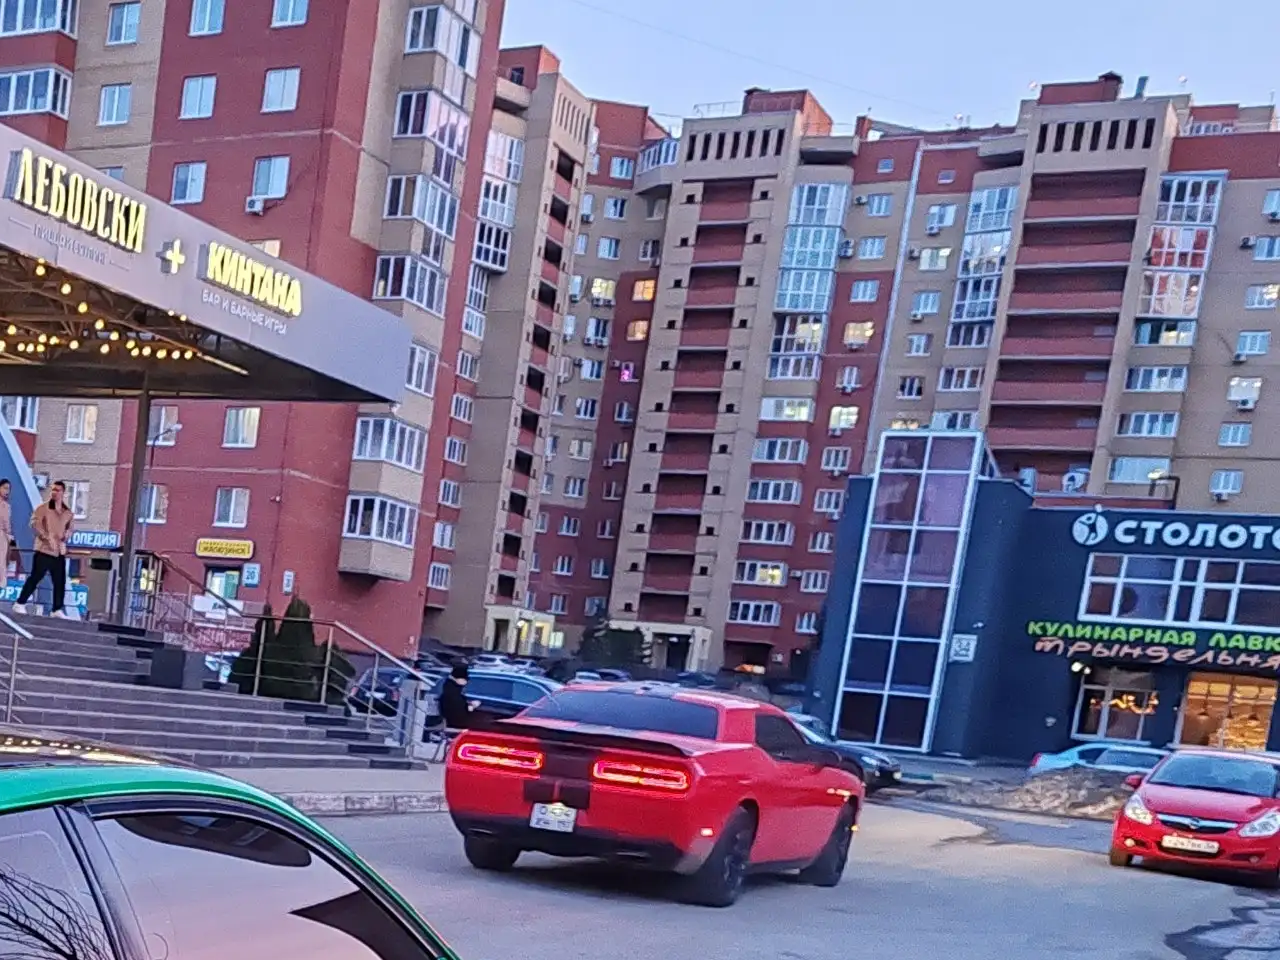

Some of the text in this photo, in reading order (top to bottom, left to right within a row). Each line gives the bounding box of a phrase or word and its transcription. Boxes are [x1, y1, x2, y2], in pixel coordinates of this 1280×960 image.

[14, 147, 147, 253] ЛЕБОВСКИ
[206, 240, 302, 317] КИНТАНА
[202, 288, 220, 305] БАР
[1028, 620, 1197, 646] КУЛИНАРНАЯ
